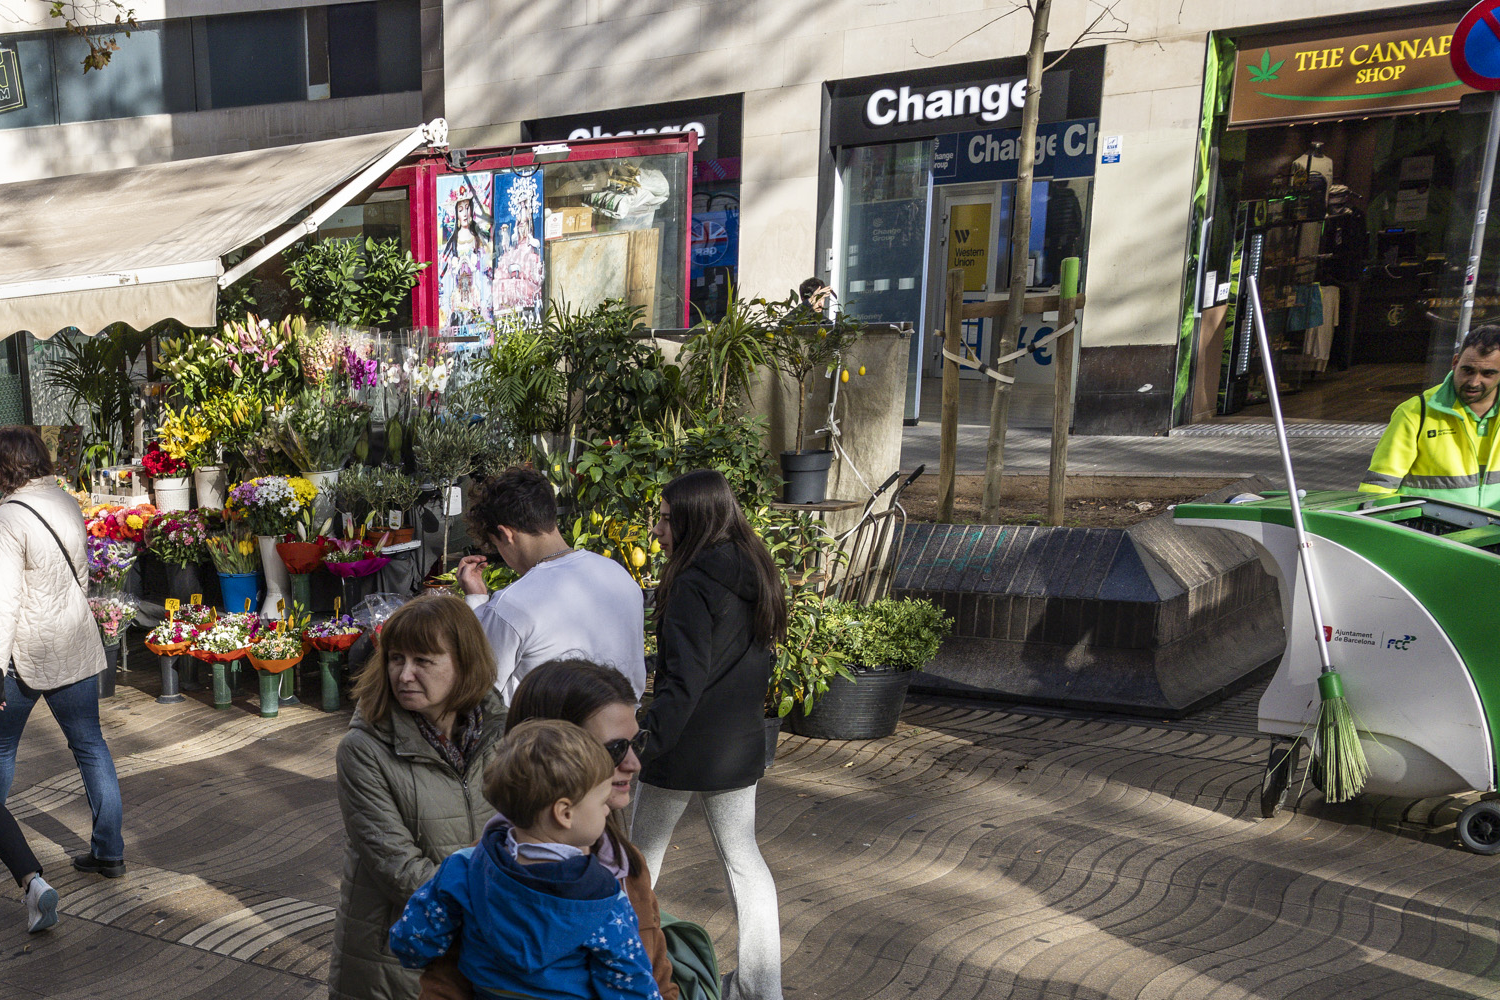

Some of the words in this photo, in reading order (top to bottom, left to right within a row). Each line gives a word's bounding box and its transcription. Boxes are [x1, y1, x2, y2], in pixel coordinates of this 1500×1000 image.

[1295, 47, 1345, 72] THE
[1350, 34, 1454, 66] CANNAB
[1355, 65, 1406, 85] SHOP
[934, 152, 954, 161] hange
[955, 248, 985, 257] Western
[954, 257, 975, 267] Union
[1335, 629, 1373, 639] Ajuntament
[1343, 637, 1376, 646] Barcelona
[1387, 638, 1411, 651] FCC
